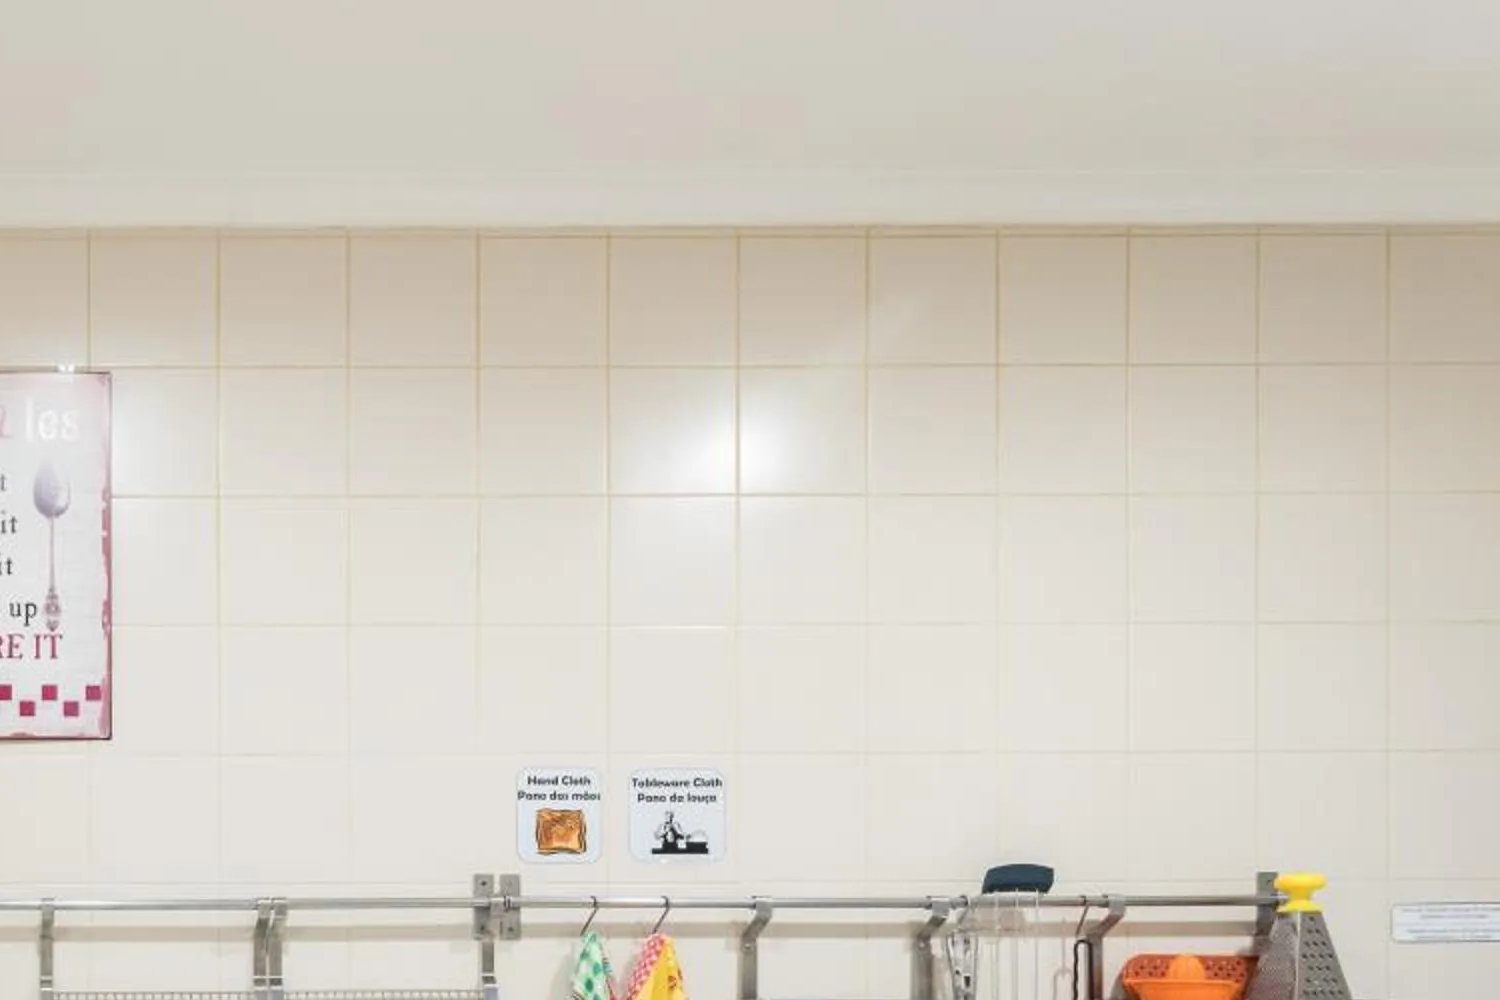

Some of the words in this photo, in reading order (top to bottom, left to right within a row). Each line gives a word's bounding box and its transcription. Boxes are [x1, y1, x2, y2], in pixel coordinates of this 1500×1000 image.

[0, 510, 18, 535] it
[9, 602, 38, 628] up
[32, 633, 64, 661] IT
[527, 775, 559, 786] Hand
[562, 775, 591, 786] Cloth
[632, 777, 690, 789] Tableware
[693, 777, 723, 789] Cloth
